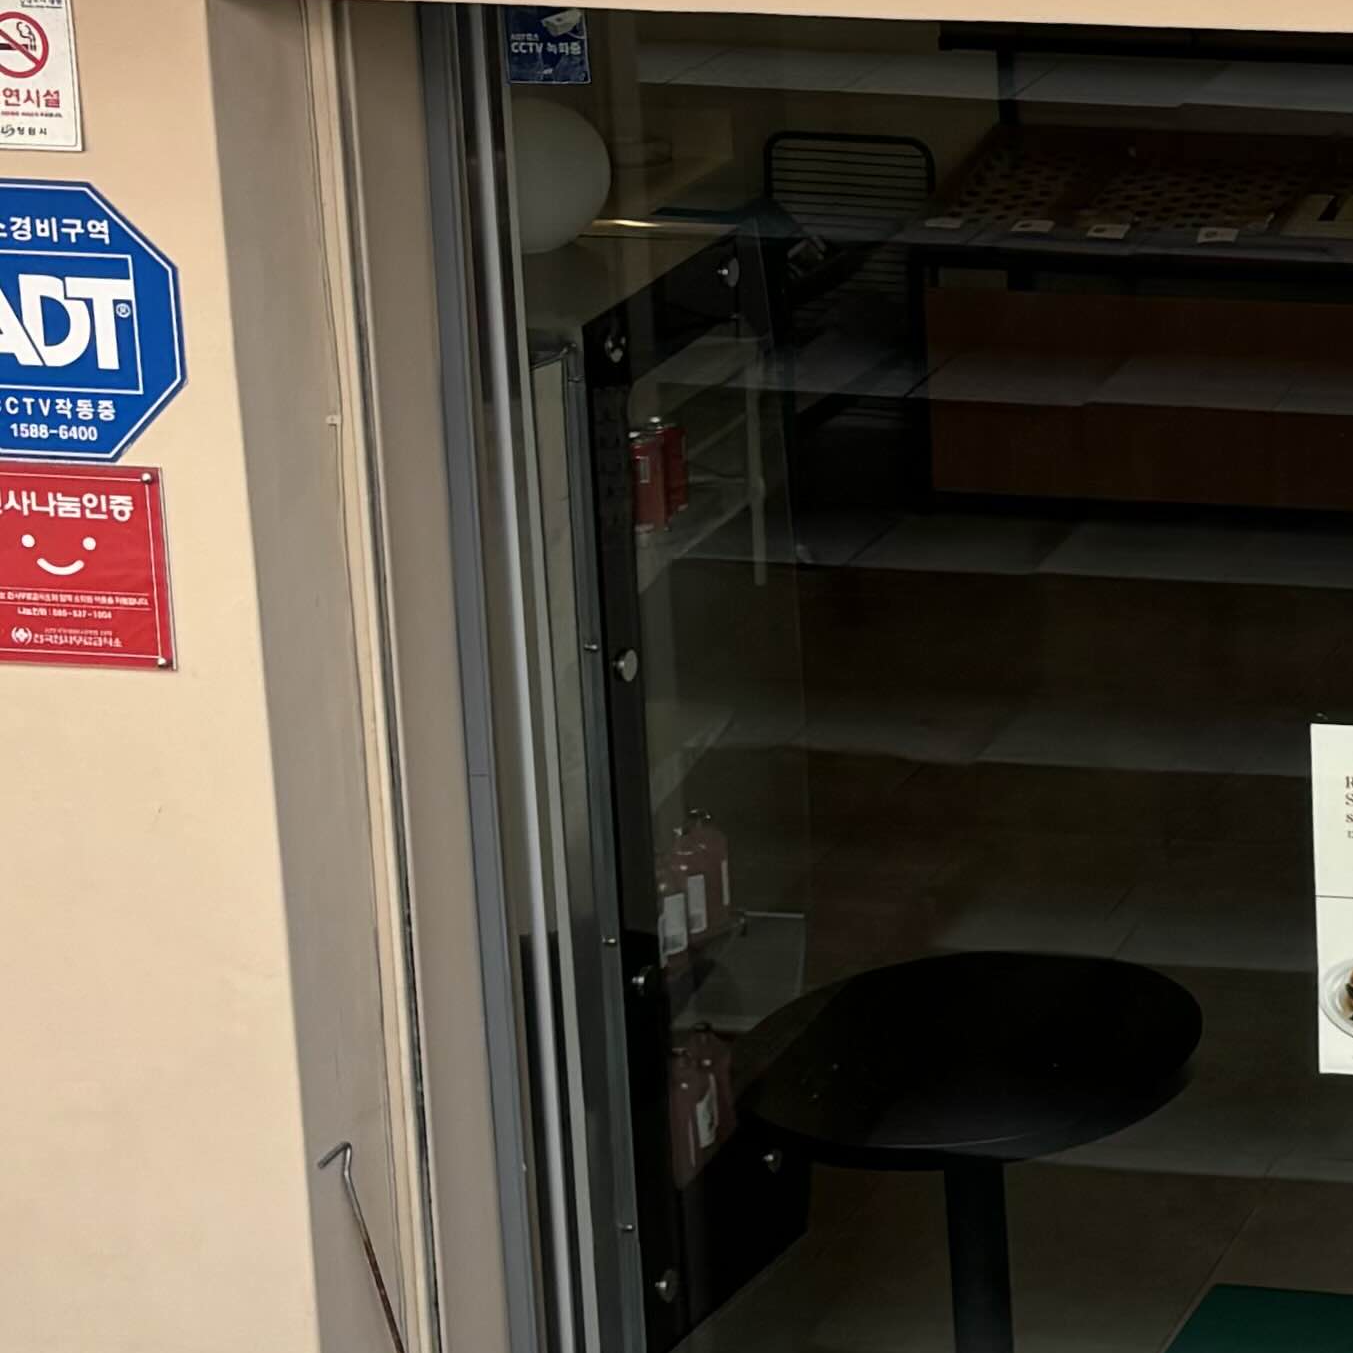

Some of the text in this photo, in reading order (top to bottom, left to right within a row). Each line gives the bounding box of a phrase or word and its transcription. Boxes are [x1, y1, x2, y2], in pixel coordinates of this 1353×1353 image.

[511, 41, 543, 54] CCTV
[0, 87, 61, 108] 연시설
[0, 397, 116, 421] CTV작동중
[10, 423, 98, 442] 1588-6400
[0, 490, 134, 522] 사나눔인증
